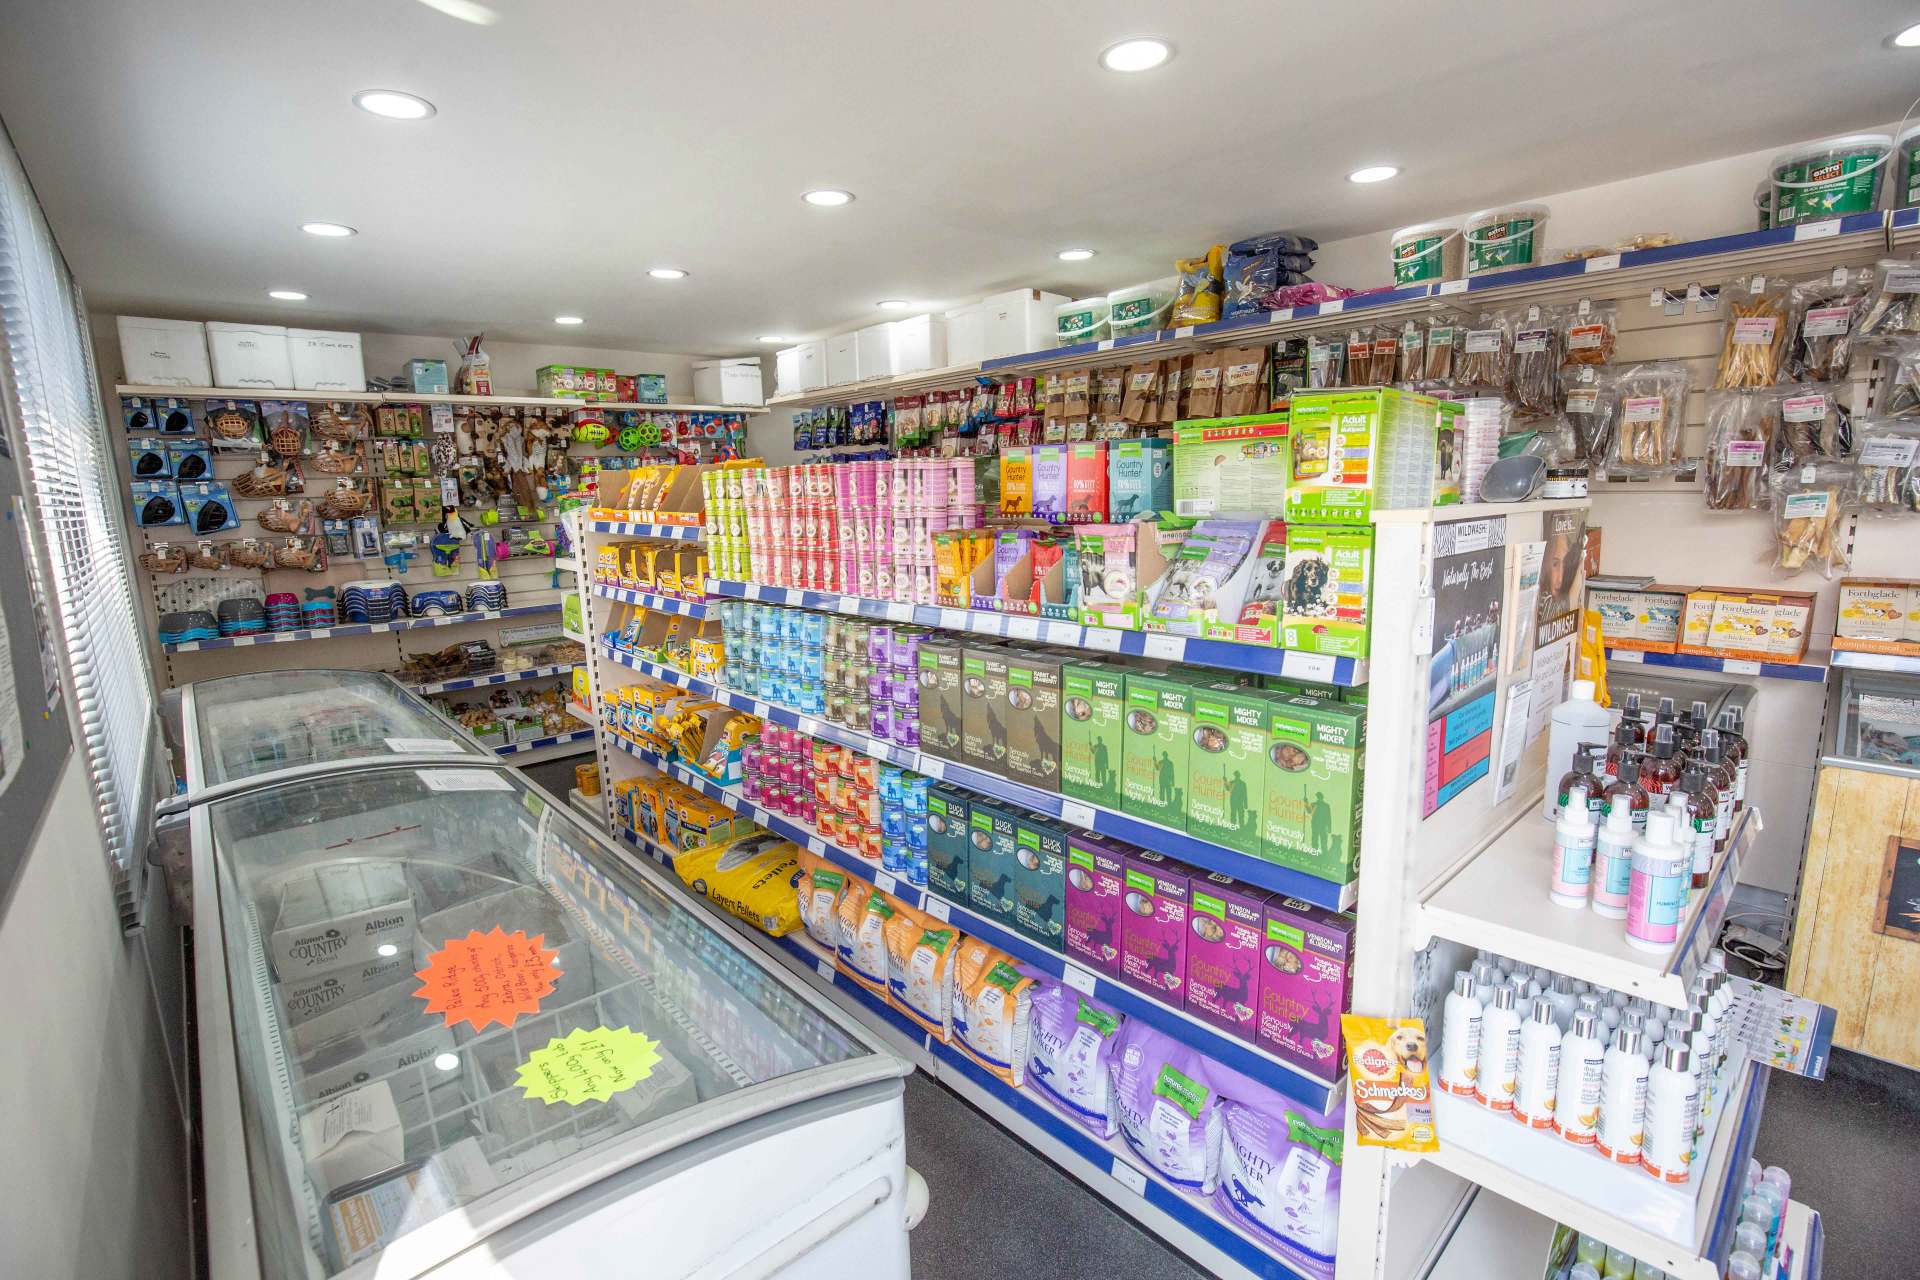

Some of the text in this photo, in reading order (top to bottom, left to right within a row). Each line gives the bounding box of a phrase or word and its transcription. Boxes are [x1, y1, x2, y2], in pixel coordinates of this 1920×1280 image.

[1813, 164, 1840, 177] extra
[1341, 415, 1366, 425] Adult
[1005, 465, 1026, 474] Country
[1117, 460, 1143, 470] Country
[1007, 473, 1025, 481] Hunter
[1118, 468, 1142, 478] Hunter
[1457, 523, 1488, 537] WILDWASH
[1335, 550, 1359, 559] Adult
[1442, 557, 1494, 591] Naturally The Best
[1594, 593, 1634, 603] Forthglade
[1644, 596, 1681, 606] Forthglad
[1847, 589, 1900, 600] Forthglade
[1721, 603, 1769, 616] Forthglade
[1538, 613, 1575, 647] WILDWASH
[1096, 680, 1117, 690] MIGHTY
[1097, 689, 1116, 697] MIXER
[1162, 691, 1187, 702] MIGHTY
[1306, 689, 1333, 699] MIGHTY
[1164, 700, 1184, 710] MIXER
[1234, 707, 1262, 718] MIGHTY
[1236, 717, 1259, 727] MIXER
[1316, 723, 1349, 737] MIGHTY
[1319, 733, 1346, 745] MIXER
[948, 803, 964, 814] DUCK
[1191, 798, 1225, 818] Seriously
[995, 819, 1012, 830] DUCK
[1266, 820, 1306, 842] Seriously
[1042, 837, 1061, 848] DUCK
[1265, 832, 1323, 857] Mighty Mixer
[752, 859, 798, 889] Pellets
[1156, 879, 1177, 891] VENISON
[712, 887, 760, 923] Layers Pellets
[1228, 903, 1251, 916] VENISON
[1230, 909, 1258, 922] BLUEBERRY
[365, 915, 405, 932] Albion
[294, 935, 325, 948] Albion
[1306, 931, 1332, 945] VENISON
[289, 935, 349, 960] COUNTRY
[1309, 938, 1340, 953] BLUEBERRY
[1124, 951, 1149, 969] Seriously
[362, 960, 400, 978] Albion
[1189, 978, 1218, 997] Seriously
[287, 984, 347, 1011] COUNTRY
[475, 992, 499, 1009] Any
[1263, 986, 1310, 1017] Country
[1264, 997, 1304, 1023] Hunter
[1261, 1010, 1294, 1032] Seriously
[1261, 1018, 1283, 1035] Meaty
[397, 1046, 439, 1068] Albion
[318, 1081, 353, 1098] Albion
[581, 1074, 602, 1094] Any
[1355, 1078, 1427, 1101] Schmackos
